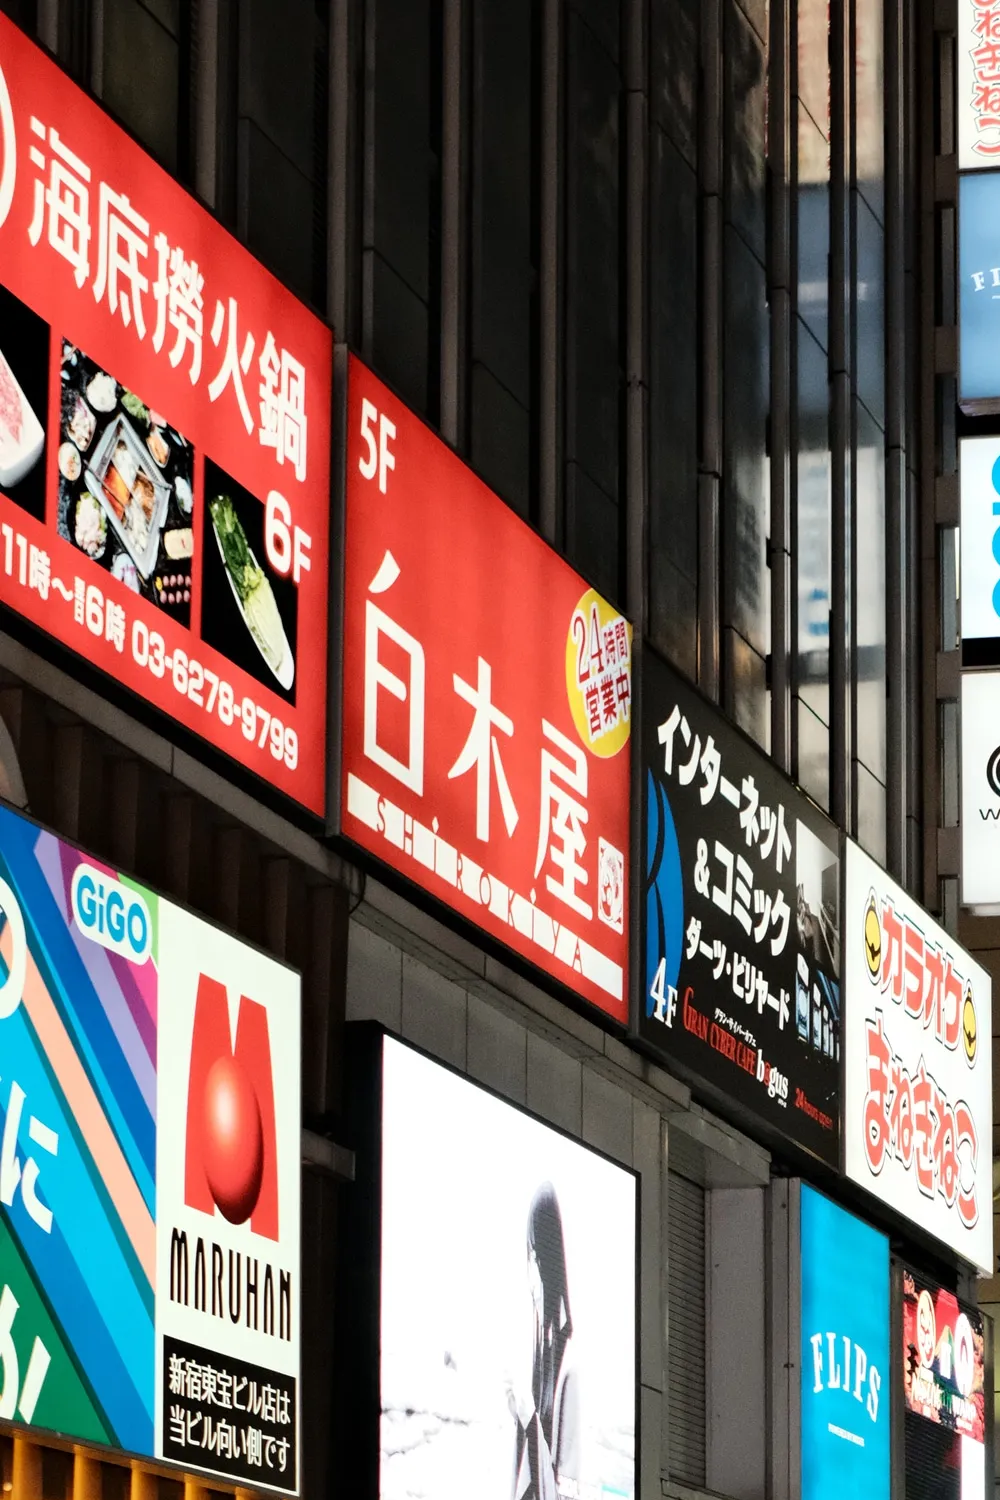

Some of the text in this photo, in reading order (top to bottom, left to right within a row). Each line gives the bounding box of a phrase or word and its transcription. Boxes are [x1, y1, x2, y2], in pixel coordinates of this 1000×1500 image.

[28, 116, 308, 482] 海底撈火鍋
[358, 397, 398, 494] 5F
[265, 490, 312, 583] 6F
[131, 619, 299, 771] 03-6278-9799
[573, 604, 628, 684] 24時間
[362, 548, 594, 922] 白木屋
[585, 664, 631, 738] 営業中
[656, 703, 793, 880] インターネット
[693, 837, 792, 957] &コミック
[649, 957, 678, 1029] 4F
[685, 915, 791, 1031] ダーツ・ビリヤード
[879, 893, 965, 1049] カラオケ
[682, 986, 737, 1064] GRAN CYBER
[865, 1006, 979, 1230] まねきねこ
[170, 1227, 292, 1342] MARUHAN
[169, 1352, 292, 1427] 新宿東宝ビル店は
[810, 1332, 882, 1424] FLIPS
[169, 1402, 291, 1476] 当ビル向い側です
